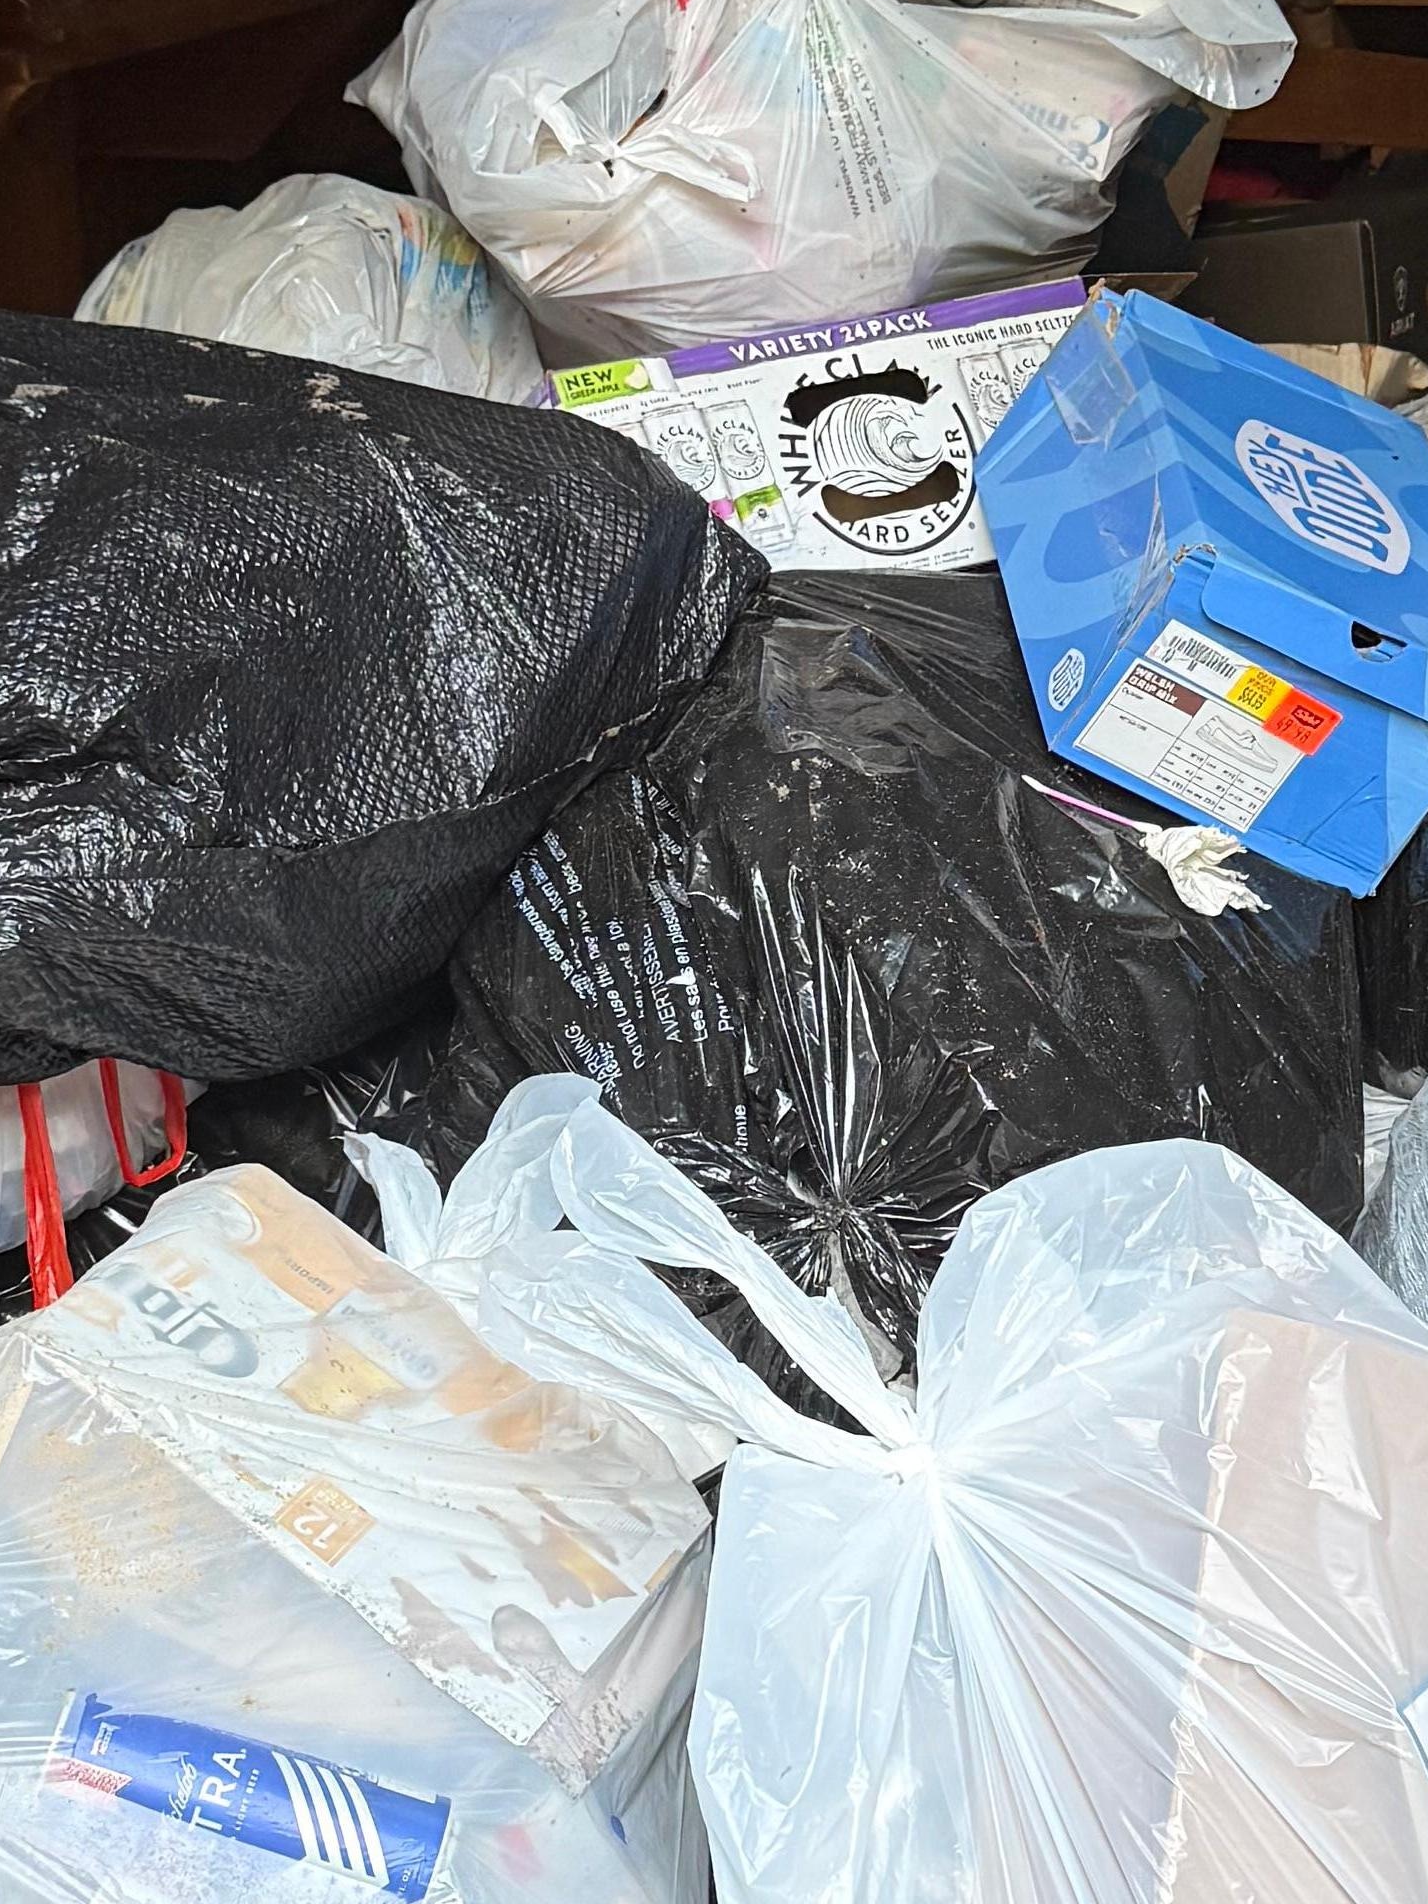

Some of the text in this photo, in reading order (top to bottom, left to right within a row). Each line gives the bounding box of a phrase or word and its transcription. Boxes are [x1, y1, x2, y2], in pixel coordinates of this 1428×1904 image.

[731, 331, 834, 362] VARIETY
[926, 336, 950, 351] THE
[952, 327, 997, 346] ICONIC
[1000, 321, 1032, 340] HARD
[565, 369, 613, 392] NEW
[1248, 438, 1299, 500] HEY
[1266, 433, 1392, 563] DUDE
[672, 943, 692, 966] en
[602, 987, 628, 1019] use
[676, 963, 703, 1008] sas
[688, 1007, 711, 1043] Les
[290, 1499, 341, 1552] 12
[186, 1740, 248, 1845] TRA
